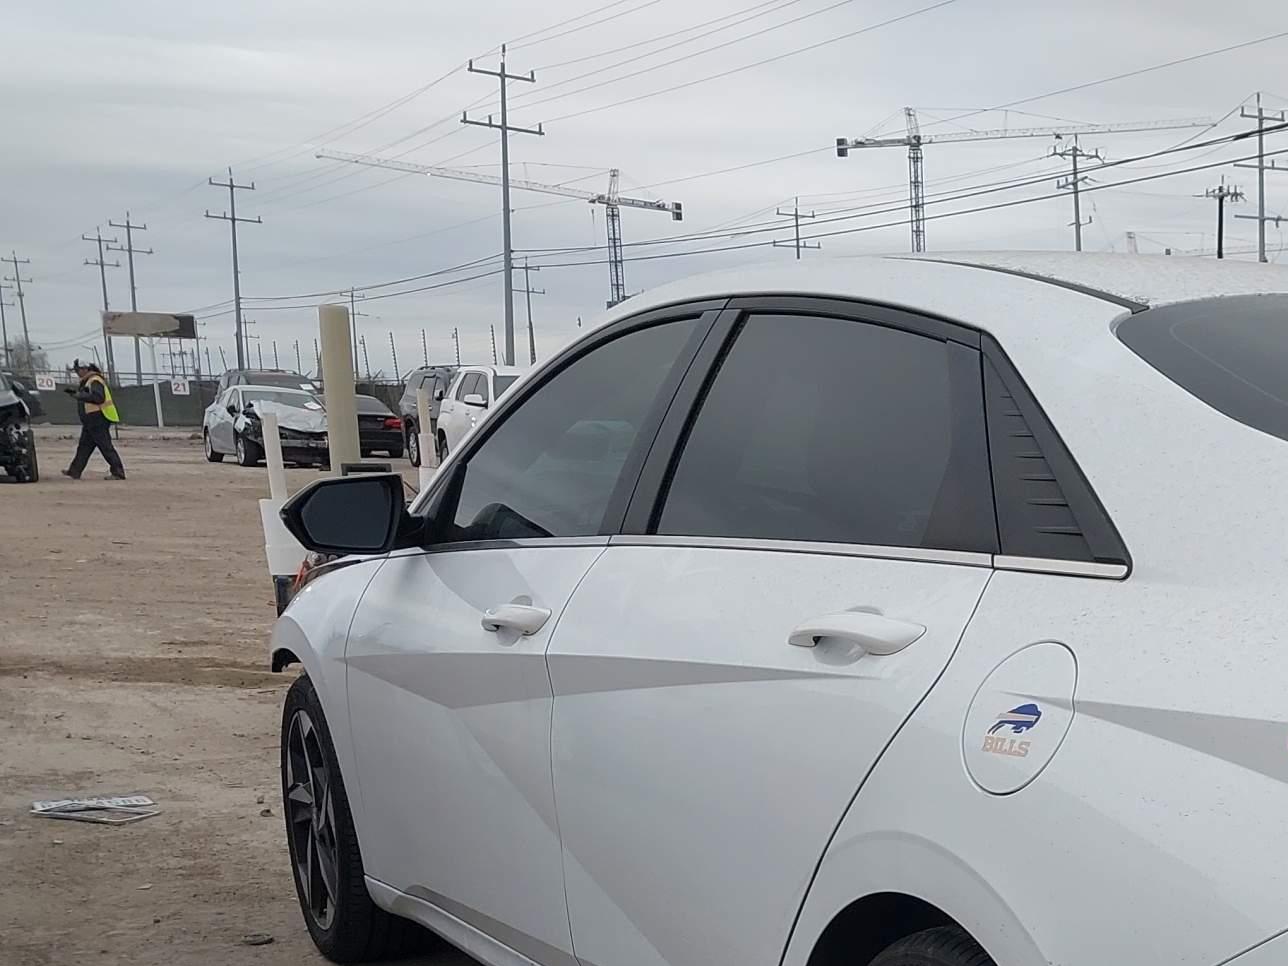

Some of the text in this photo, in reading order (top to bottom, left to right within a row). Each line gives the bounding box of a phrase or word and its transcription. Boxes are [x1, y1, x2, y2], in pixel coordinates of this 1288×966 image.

[38, 378, 53, 388] 20
[174, 382, 187, 392] 21
[982, 736, 1031, 758] BILLS
